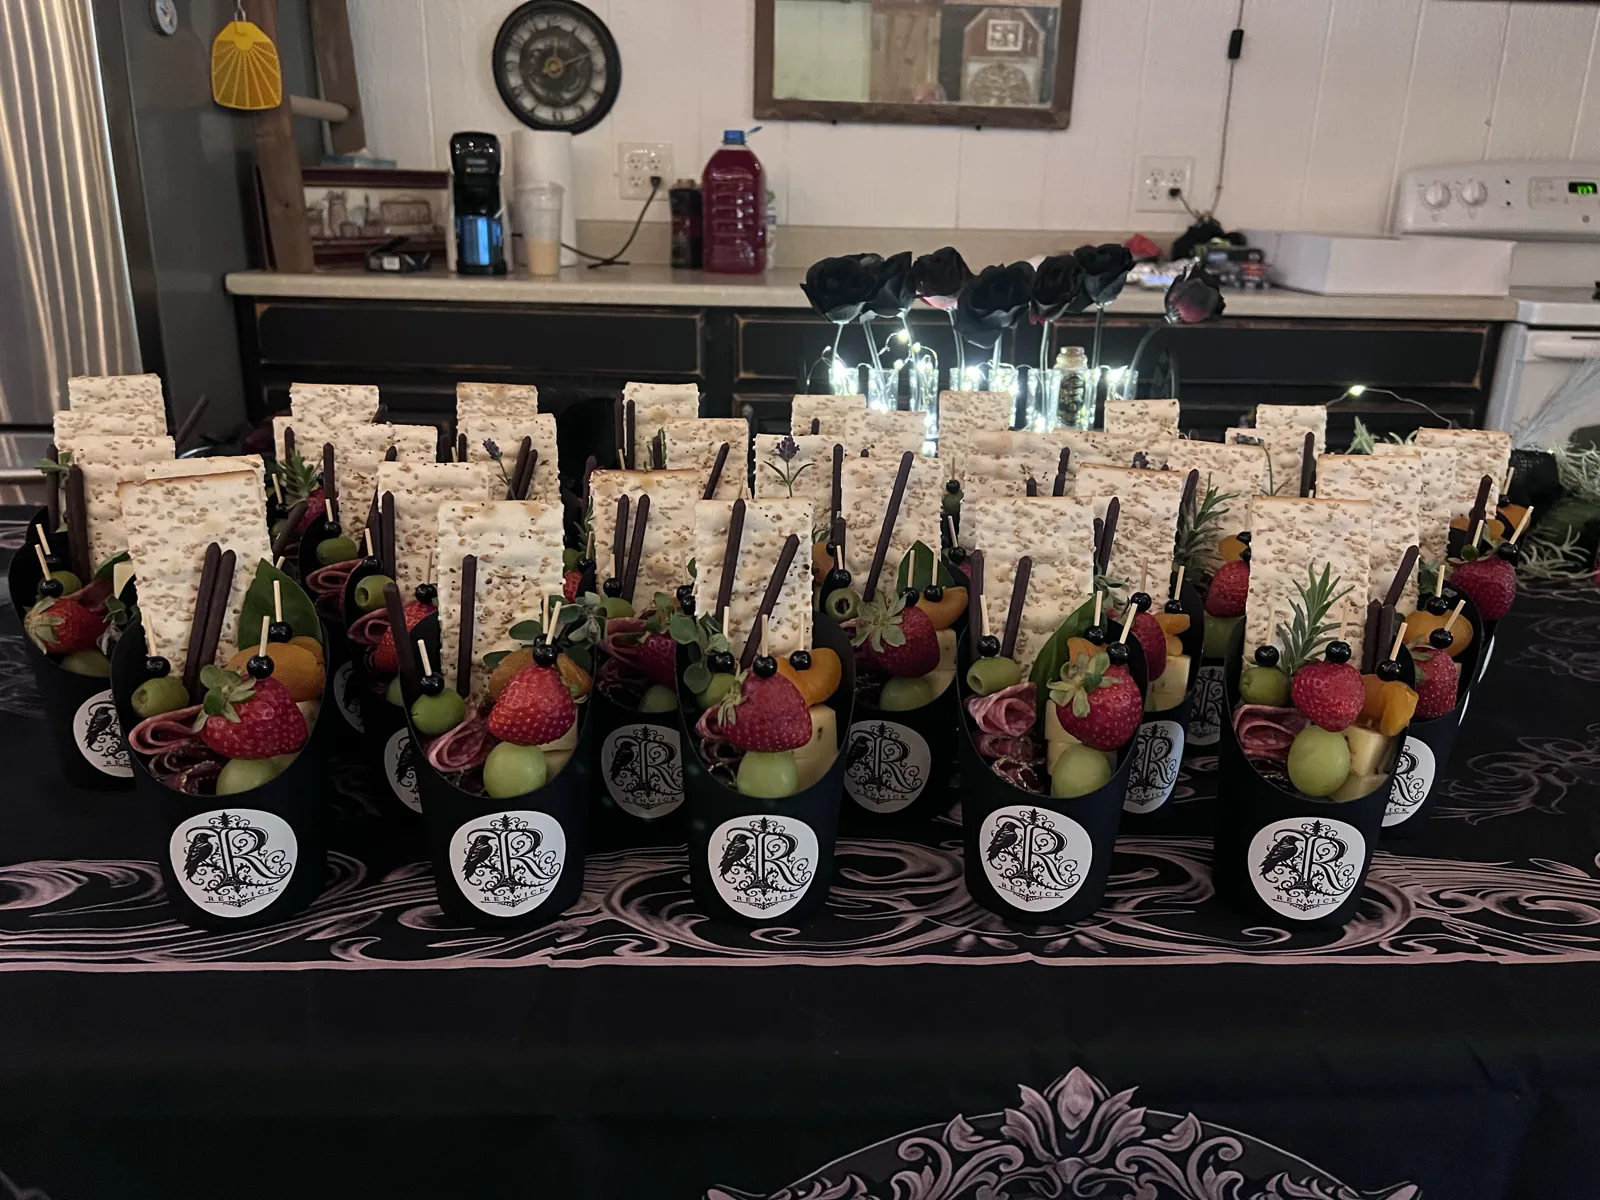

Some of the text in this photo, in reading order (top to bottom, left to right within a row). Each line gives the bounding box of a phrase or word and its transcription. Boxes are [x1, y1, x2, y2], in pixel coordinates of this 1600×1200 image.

[624, 796, 678, 804] RENWICK
[855, 788, 907, 800] RENWICK
[186, 827, 292, 887] R
[466, 828, 561, 887] R
[726, 827, 812, 891] R
[997, 816, 1081, 891] R
[1273, 829, 1357, 896] R
[207, 886, 277, 903] RENWICK
[483, 886, 549, 903] RENWICK
[735, 892, 797, 904] RENWICK
[1000, 881, 1062, 898] RENWICK
[1275, 894, 1339, 905] RENWICK
